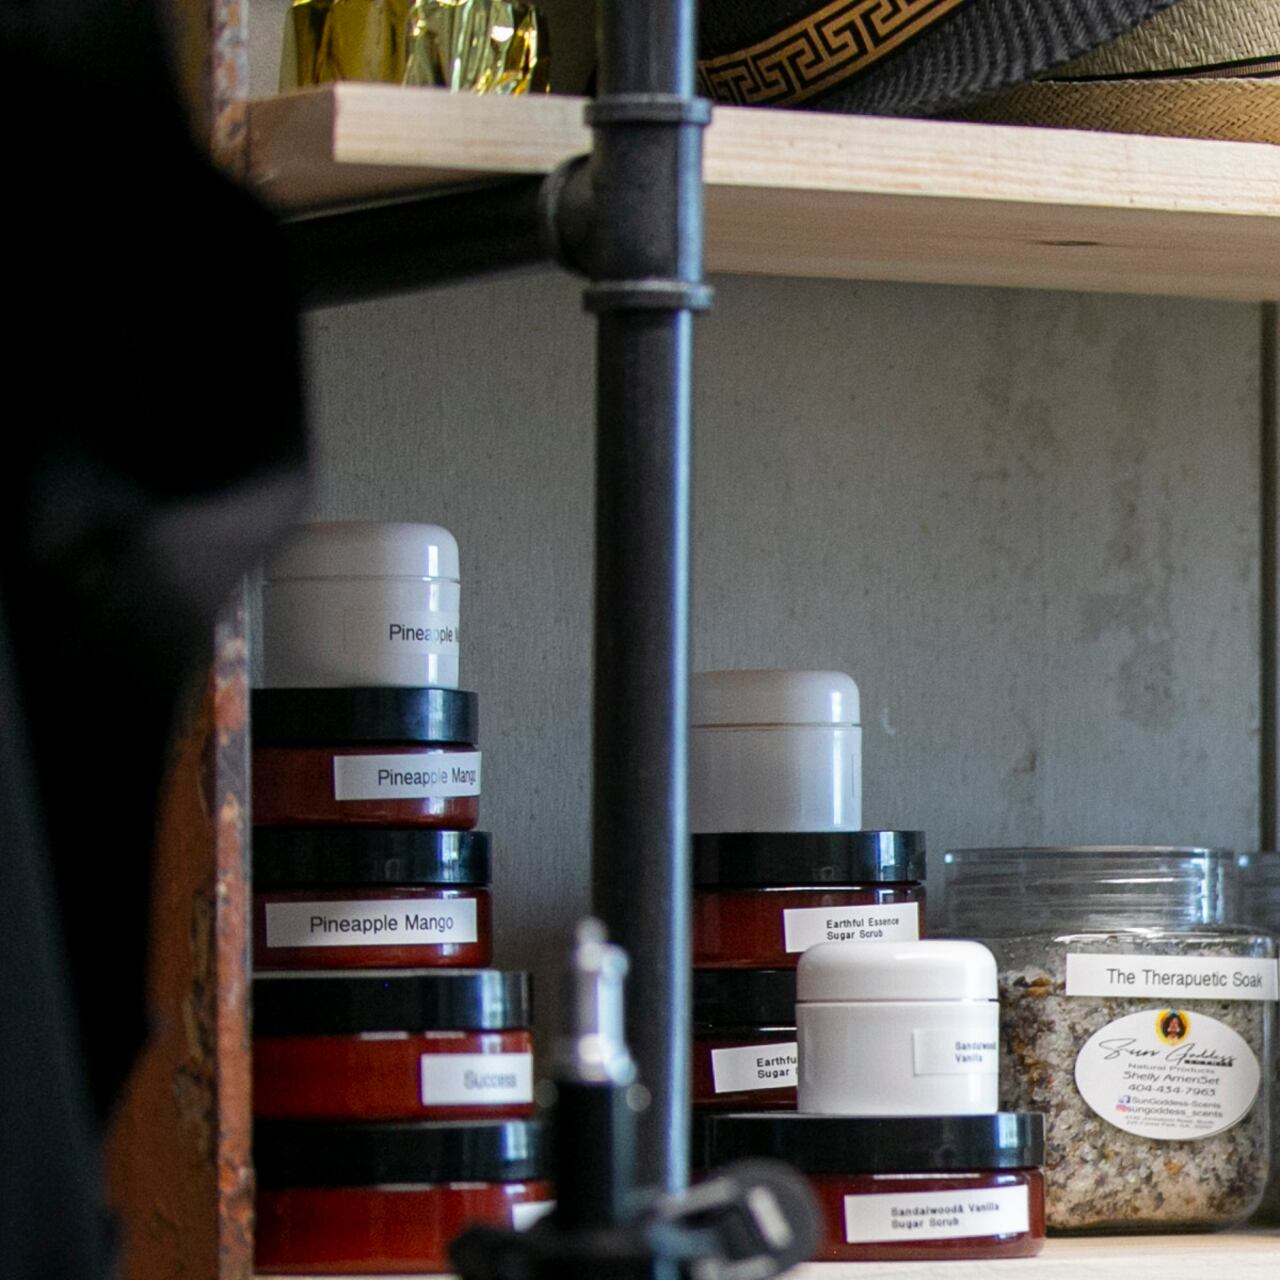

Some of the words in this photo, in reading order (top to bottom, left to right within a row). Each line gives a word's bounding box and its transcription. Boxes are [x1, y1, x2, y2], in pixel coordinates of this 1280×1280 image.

[378, 768, 448, 787] Pineapple
[309, 914, 398, 935] Pineapple
[404, 913, 454, 933] Mango
[826, 918, 865, 929] Earthful
[868, 917, 899, 927] Essence
[826, 930, 855, 941] Sugar
[859, 929, 883, 939] Scrub
[1106, 968, 1136, 985] The
[1142, 969, 1228, 989] Therapuetic
[1232, 971, 1263, 989] Soak
[756, 1055, 798, 1068] Earthfu
[757, 1068, 790, 1079] Sugar
[1122, 1070, 1161, 1083] Shelly
[968, 1202, 1000, 1213] Vanilla
[891, 1218, 924, 1230] Sugar
[929, 1217, 960, 1228] Scrub
